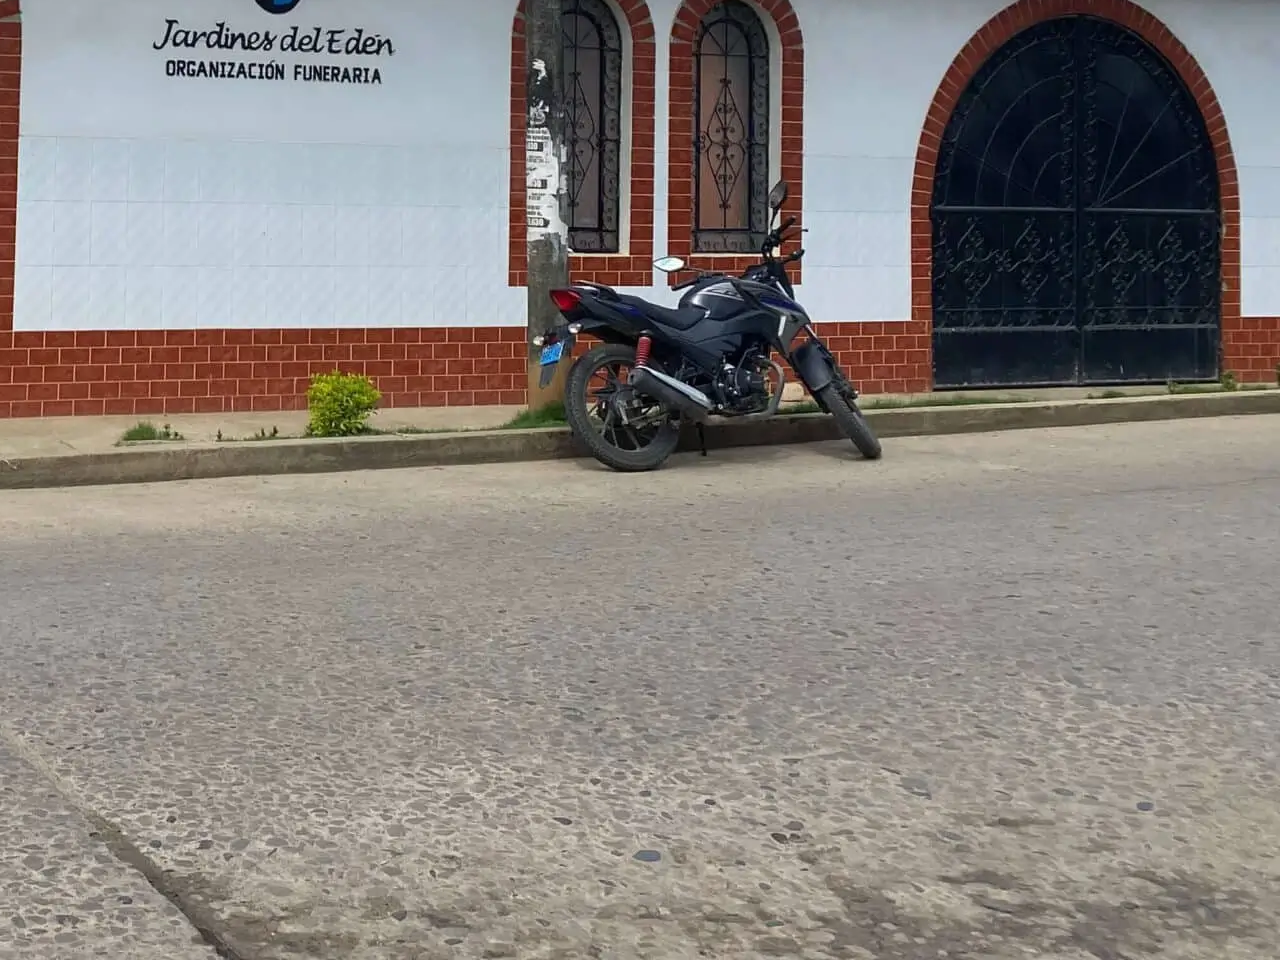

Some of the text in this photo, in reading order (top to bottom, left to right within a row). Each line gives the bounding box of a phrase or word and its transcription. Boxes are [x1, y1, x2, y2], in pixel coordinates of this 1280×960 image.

[153, 18, 277, 50] Jardines
[280, 25, 324, 53] del
[166, 60, 382, 84] ORGANIZACIÓN FUNERARIA
